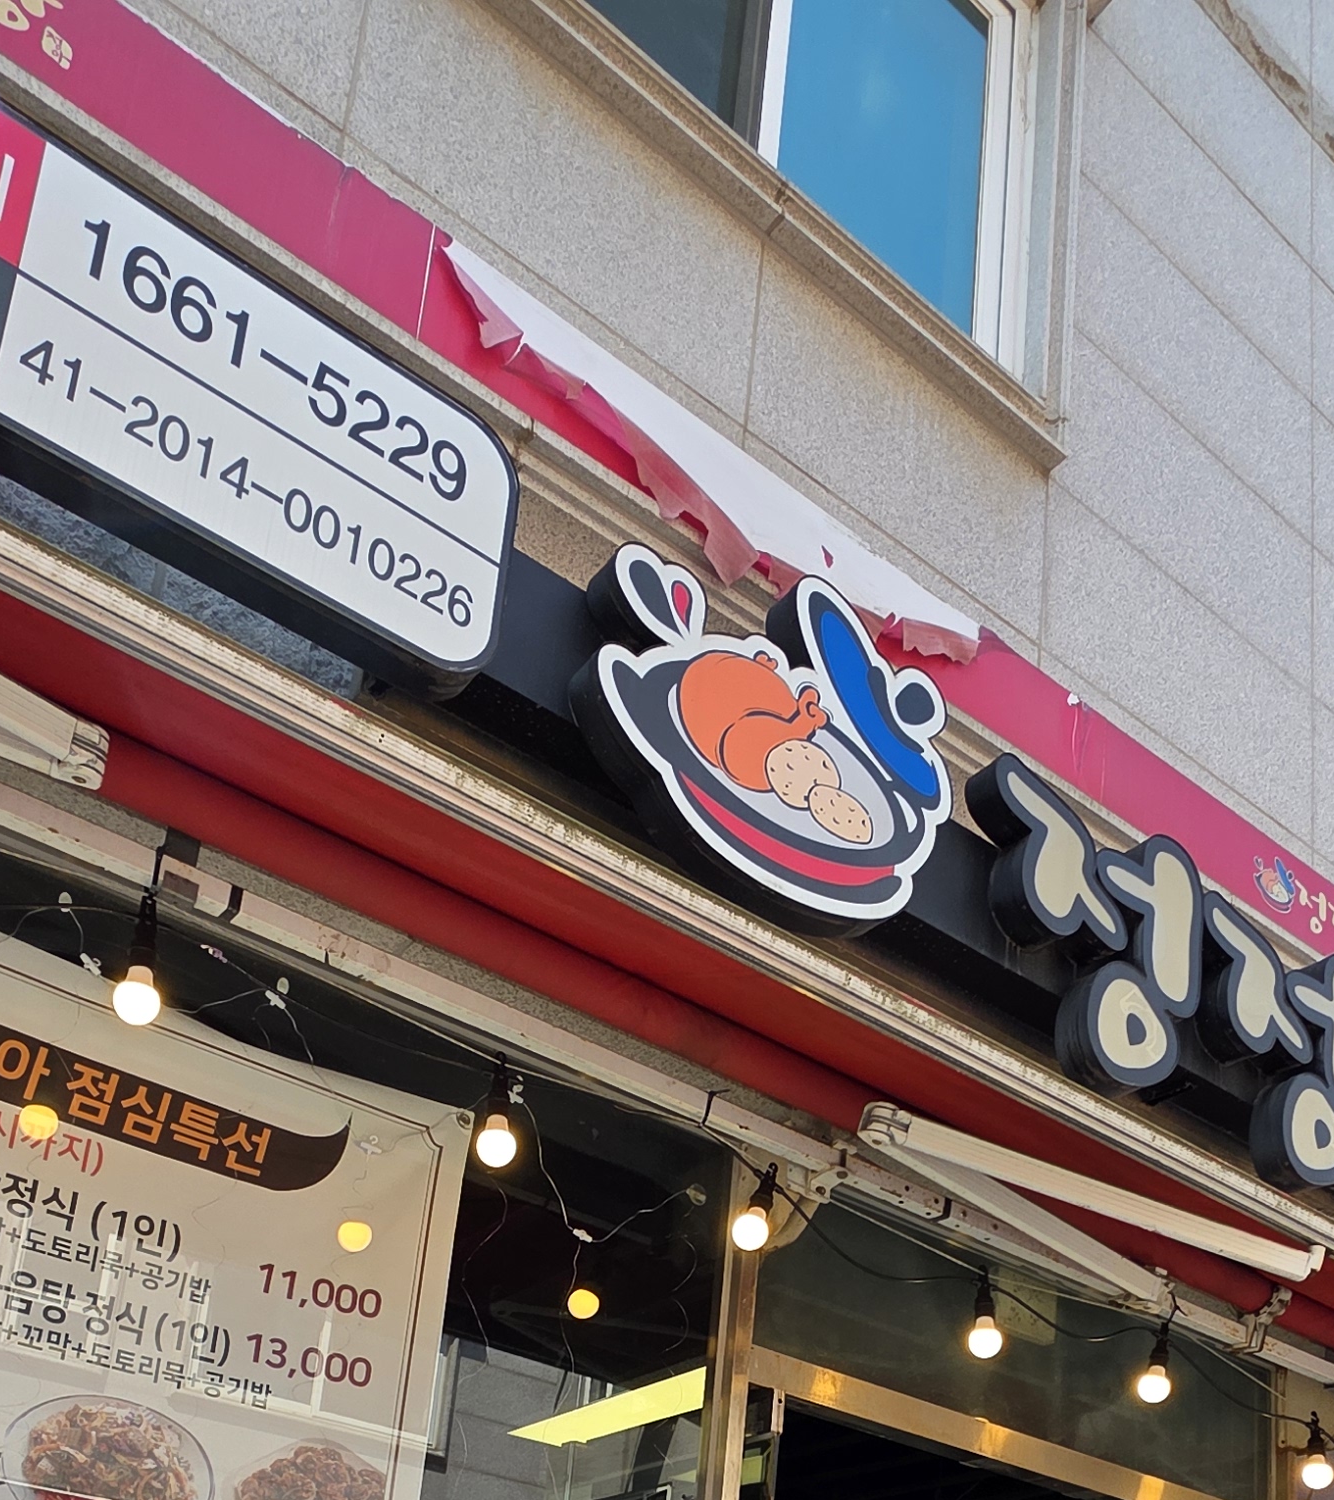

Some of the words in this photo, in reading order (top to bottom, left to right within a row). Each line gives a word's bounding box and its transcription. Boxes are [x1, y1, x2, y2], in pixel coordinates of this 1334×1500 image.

[81, 217, 468, 504] 1661-5229
[19, 338, 475, 629] 41-2014-0010226
[66, 1062, 272, 1178] 점심특선
[90, 1200, 182, 1263] (1인)
[82, 1290, 148, 1347] 정식
[154, 1311, 231, 1368] (1인)
[246, 1332, 373, 1389] 13,000
[259, 1263, 382, 1319] 11,000
